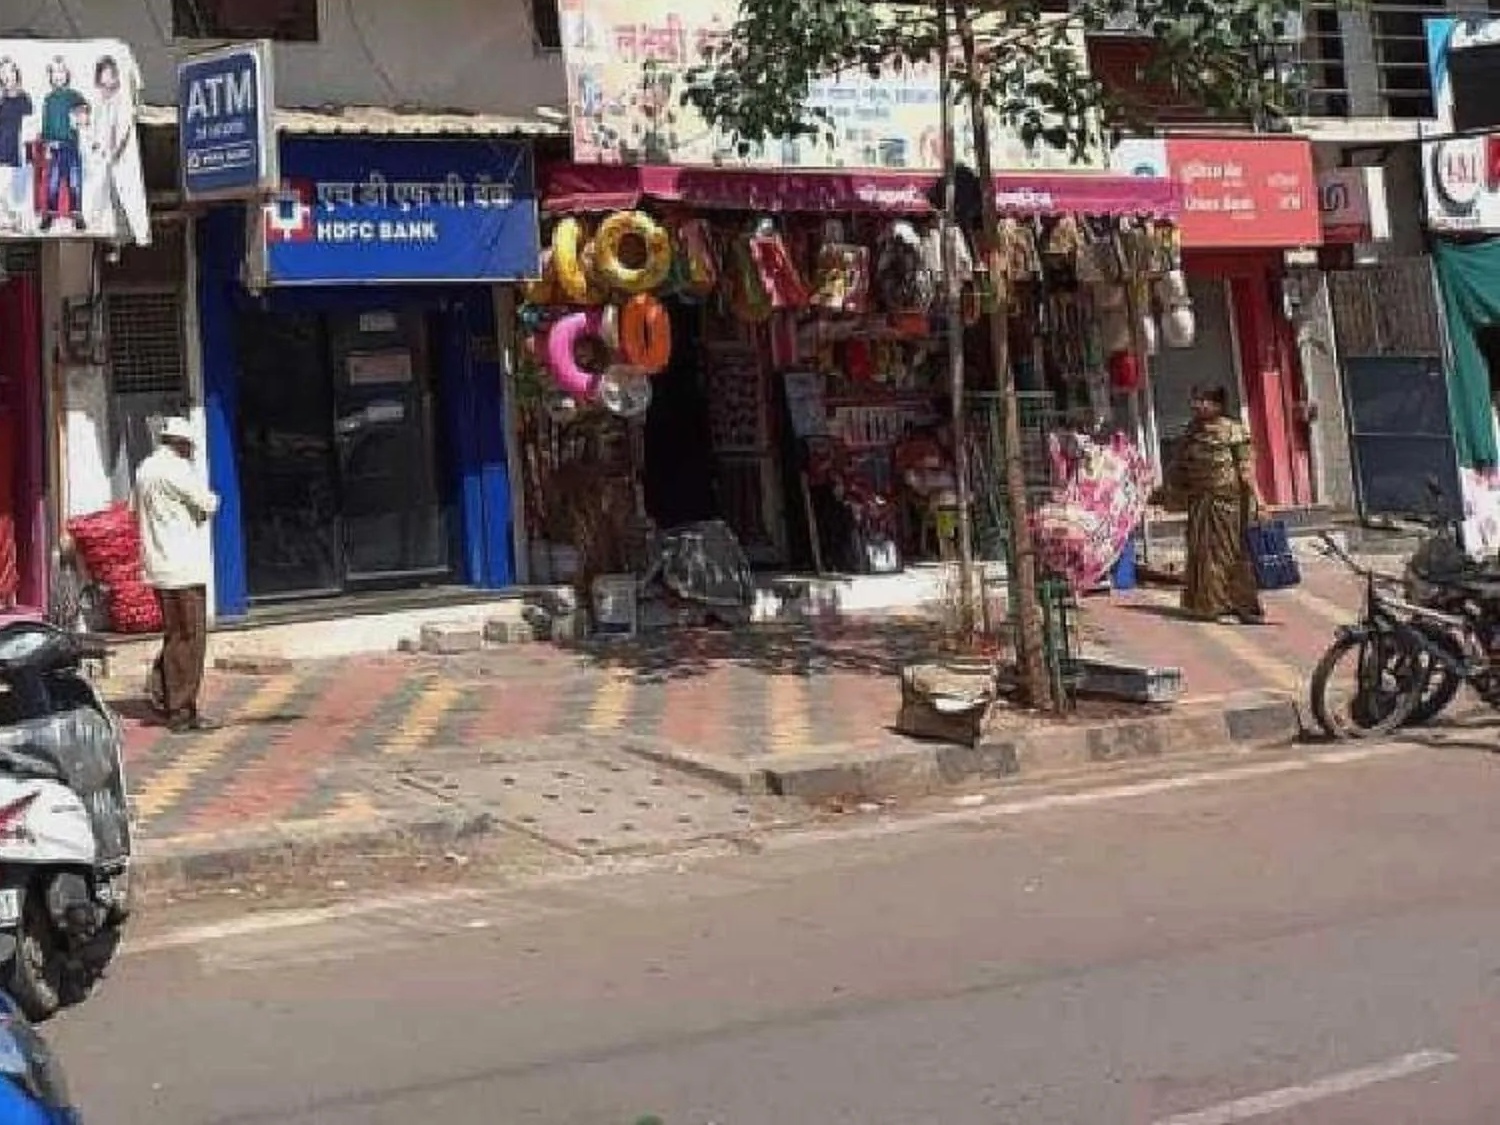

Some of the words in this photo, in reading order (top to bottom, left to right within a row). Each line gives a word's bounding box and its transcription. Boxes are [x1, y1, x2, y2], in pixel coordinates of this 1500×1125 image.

[187, 69, 251, 123] ATM
[317, 222, 375, 242] HDFC
[379, 222, 438, 242] BANK
